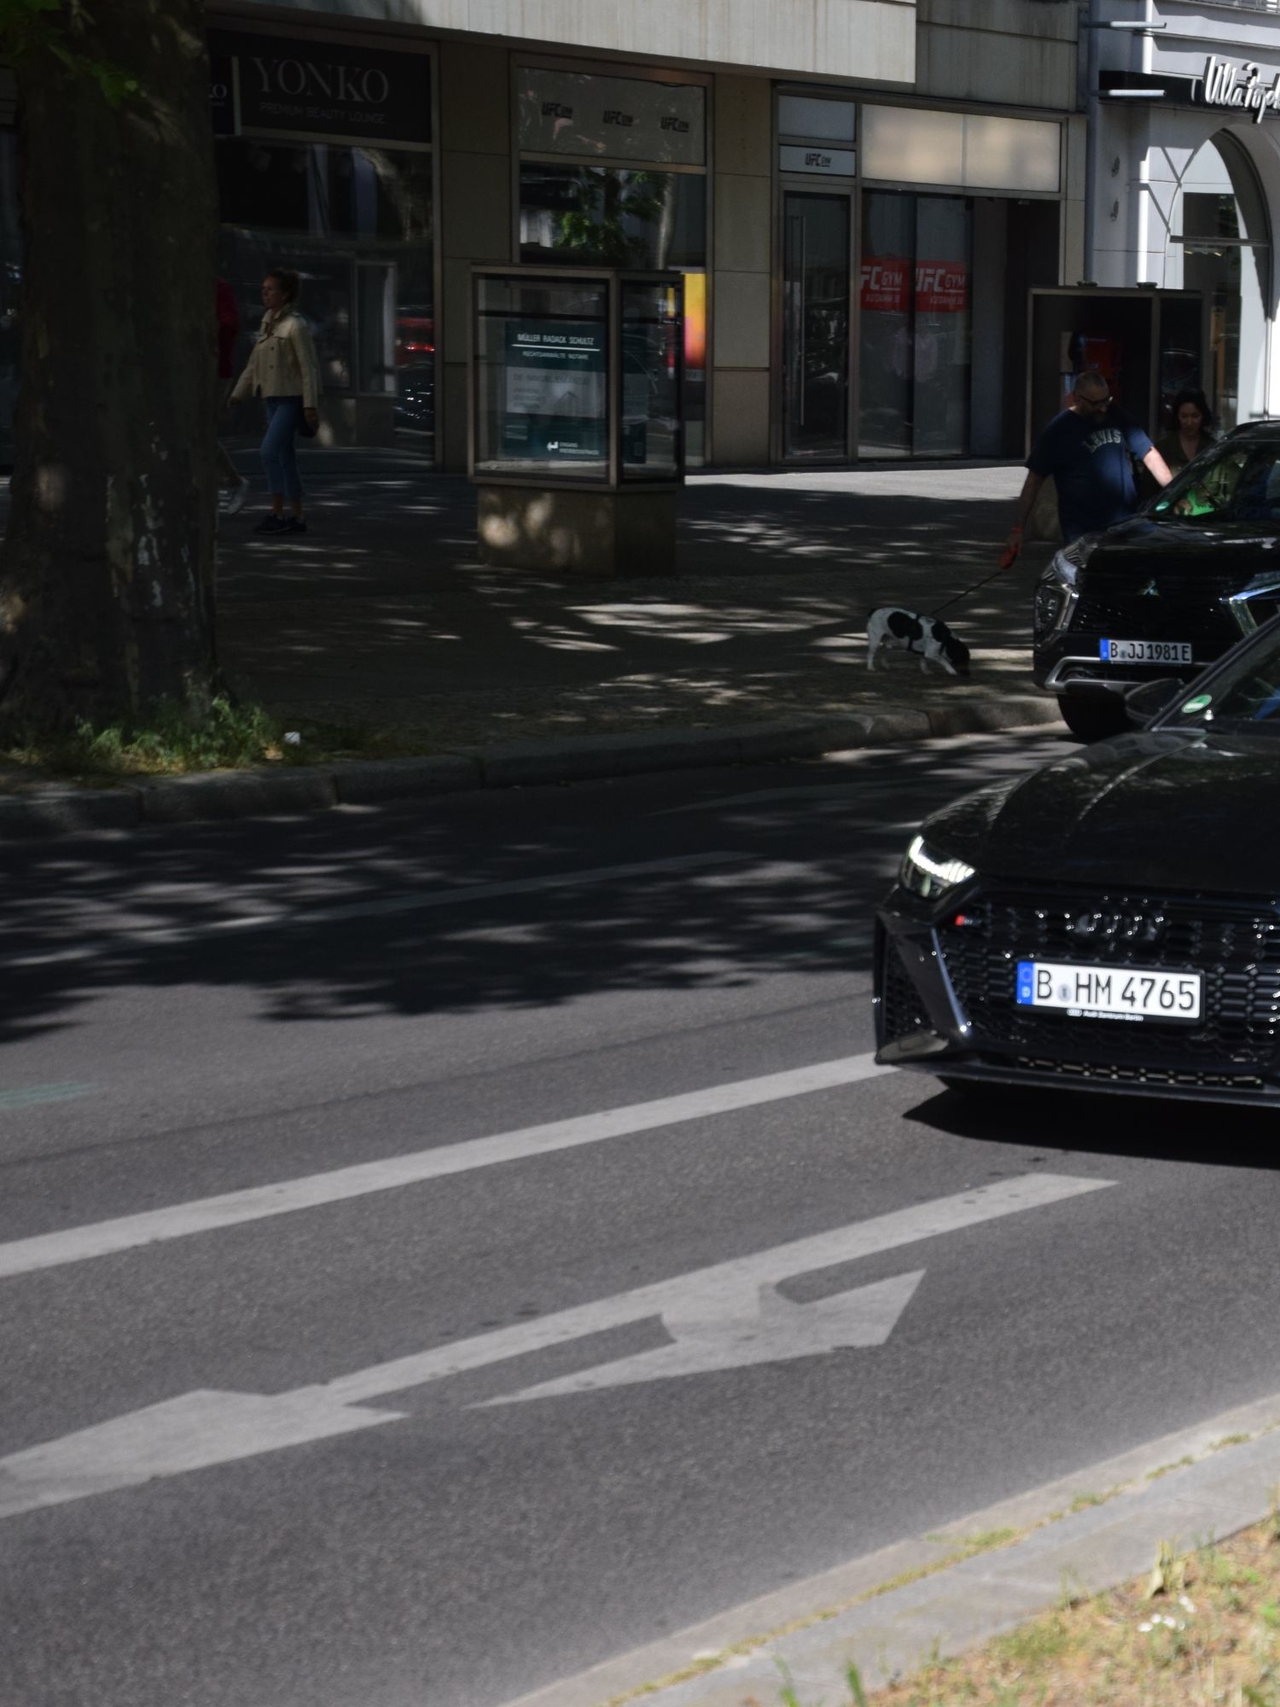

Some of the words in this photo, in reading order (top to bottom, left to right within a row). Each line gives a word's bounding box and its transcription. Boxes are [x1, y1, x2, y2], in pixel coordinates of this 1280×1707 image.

[250, 56, 389, 104] YONKO
[1205, 56, 1244, 106] Ulla
[259, 102, 303, 117] PREMIUM
[306, 106, 345, 122] BEAUTY
[348, 110, 386, 125] LOUNGE
[541, 102, 561, 117] UFC
[603, 110, 622, 125] UFC
[660, 116, 679, 131] UFC
[805, 153, 820, 167] UFC
[821, 156, 832, 165] GYM
[860, 266, 882, 291] FC
[881, 271, 903, 287] GYM
[915, 267, 946, 292] UFC
[945, 274, 966, 289] GYM
[1036, 969, 1052, 1000] B
[1075, 971, 1112, 1005] HM
[1121, 976, 1196, 1011] 4765
